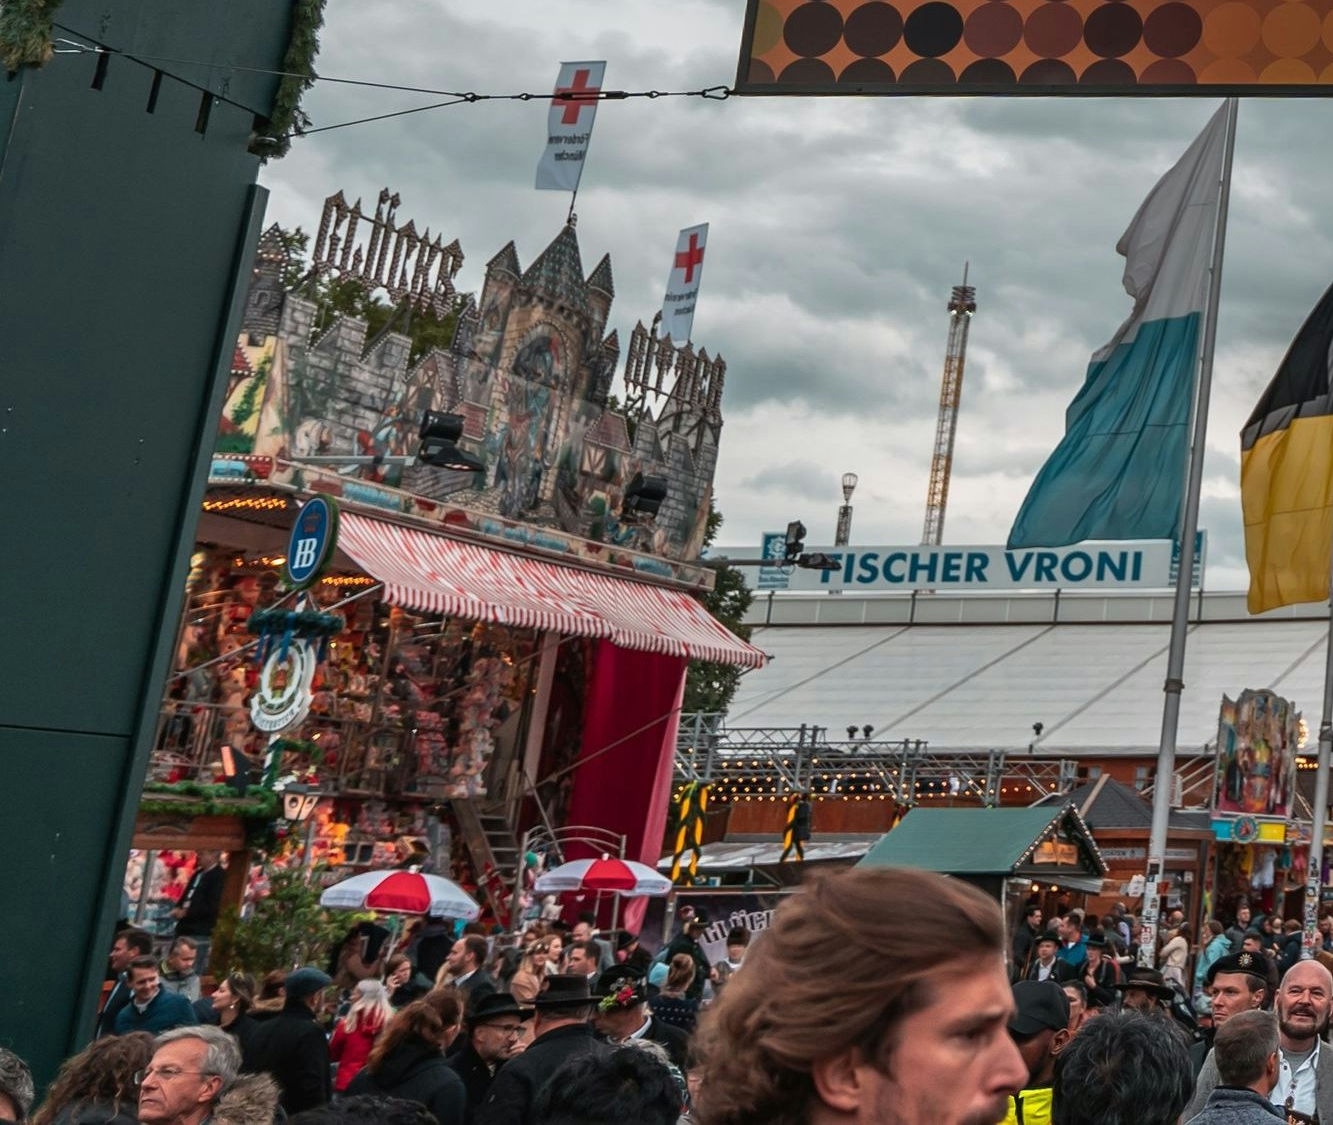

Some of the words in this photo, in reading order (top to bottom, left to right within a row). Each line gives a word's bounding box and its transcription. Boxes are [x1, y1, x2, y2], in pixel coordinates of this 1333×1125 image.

[293, 537, 318, 570] HB
[819, 551, 990, 584] FISCHER
[1005, 550, 1143, 582] VRONI
